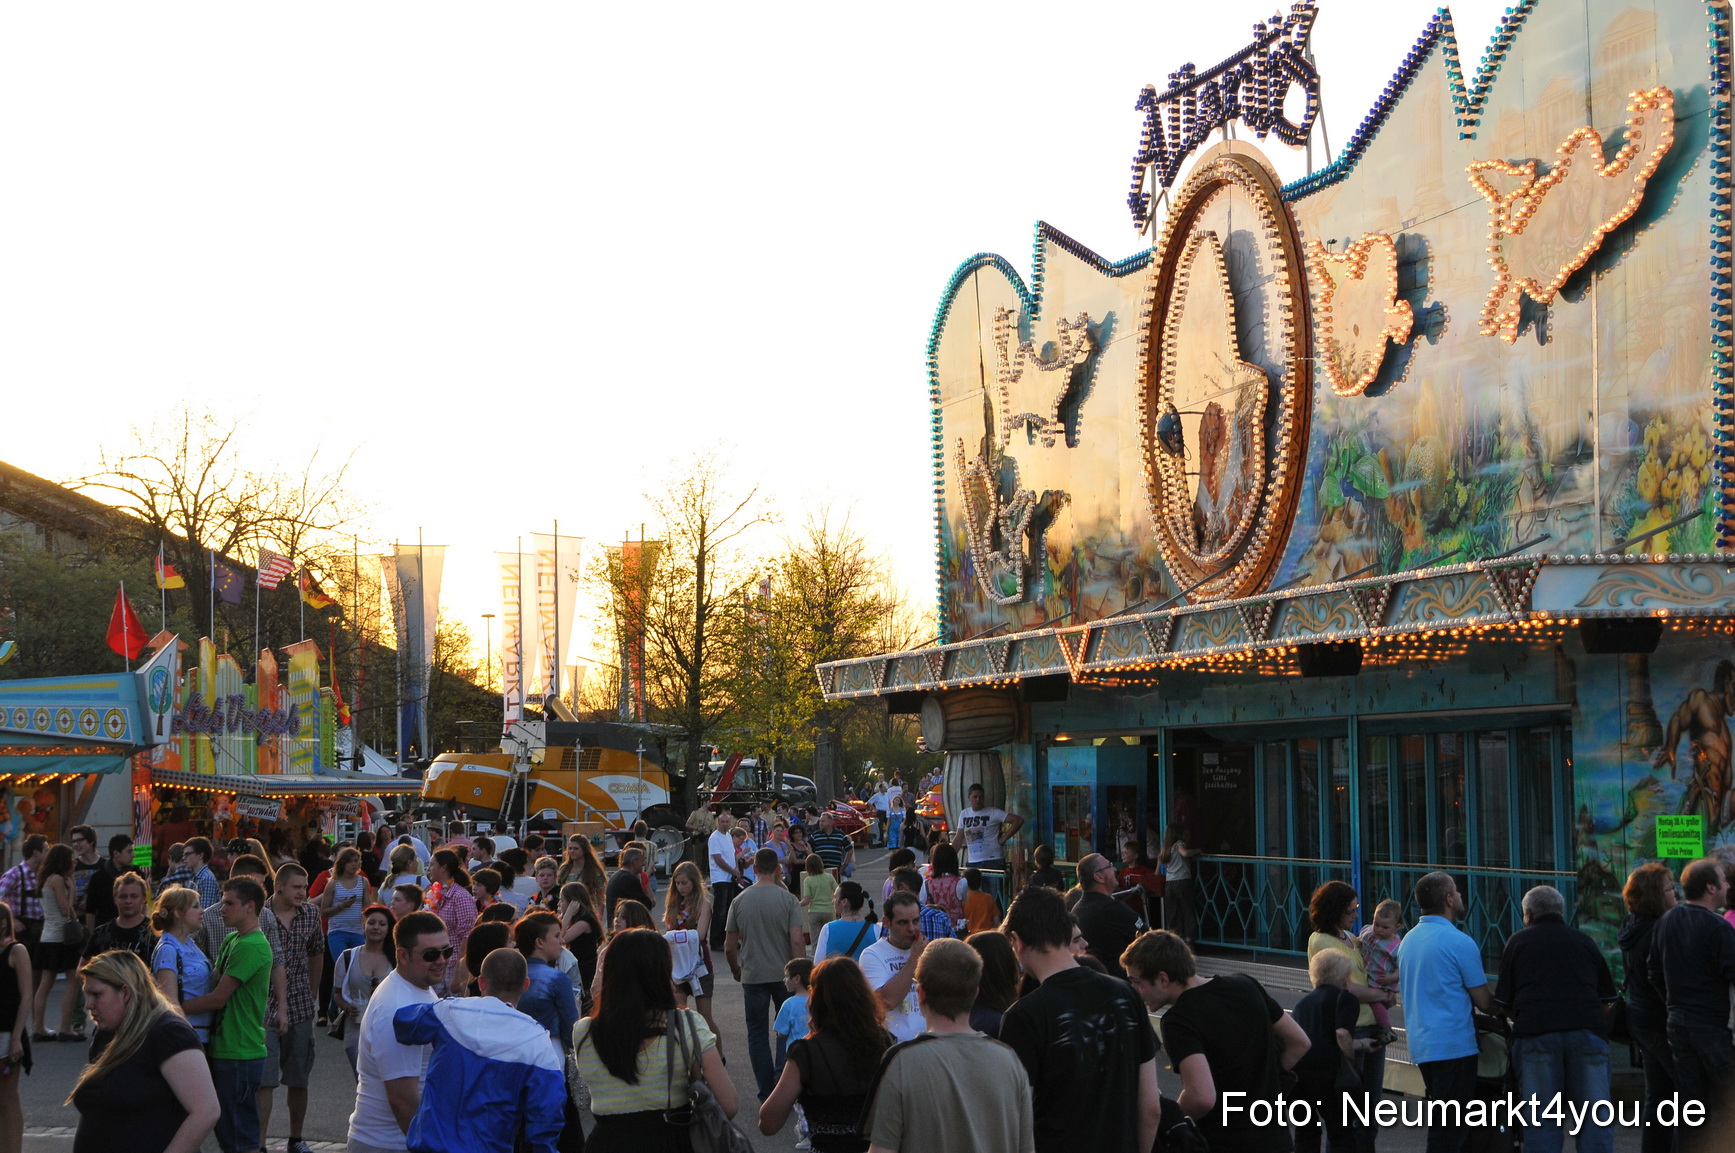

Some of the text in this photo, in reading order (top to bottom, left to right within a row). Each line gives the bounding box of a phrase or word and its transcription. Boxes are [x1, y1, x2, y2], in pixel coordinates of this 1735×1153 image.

[1658, 817, 1673, 827] Montag
[1666, 847, 1693, 856] halbe Preise
